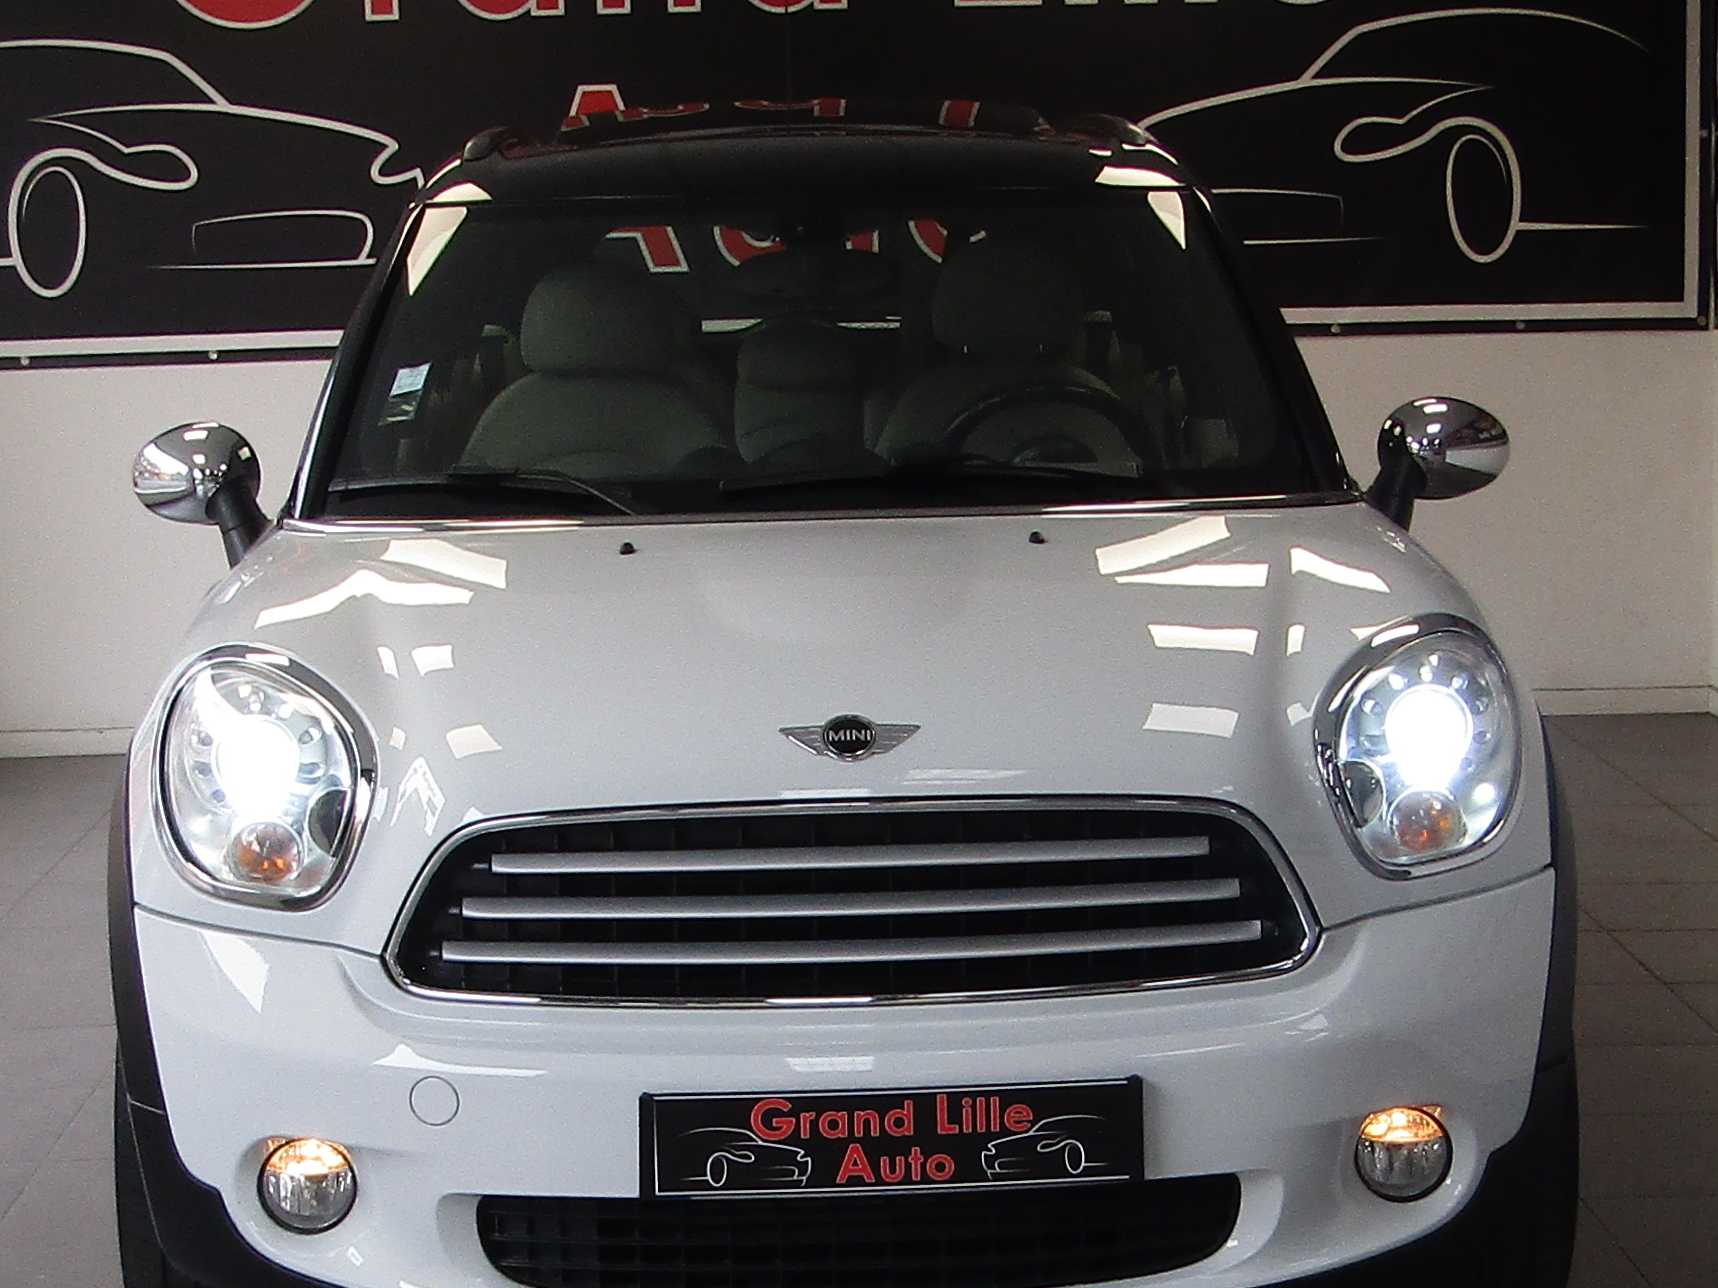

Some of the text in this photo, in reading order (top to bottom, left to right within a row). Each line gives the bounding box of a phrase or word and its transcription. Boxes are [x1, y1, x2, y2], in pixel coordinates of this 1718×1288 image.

[828, 729, 872, 742] MINI
[750, 1094, 1033, 1141] Grand Lille
[835, 1143, 955, 1184] Auto
